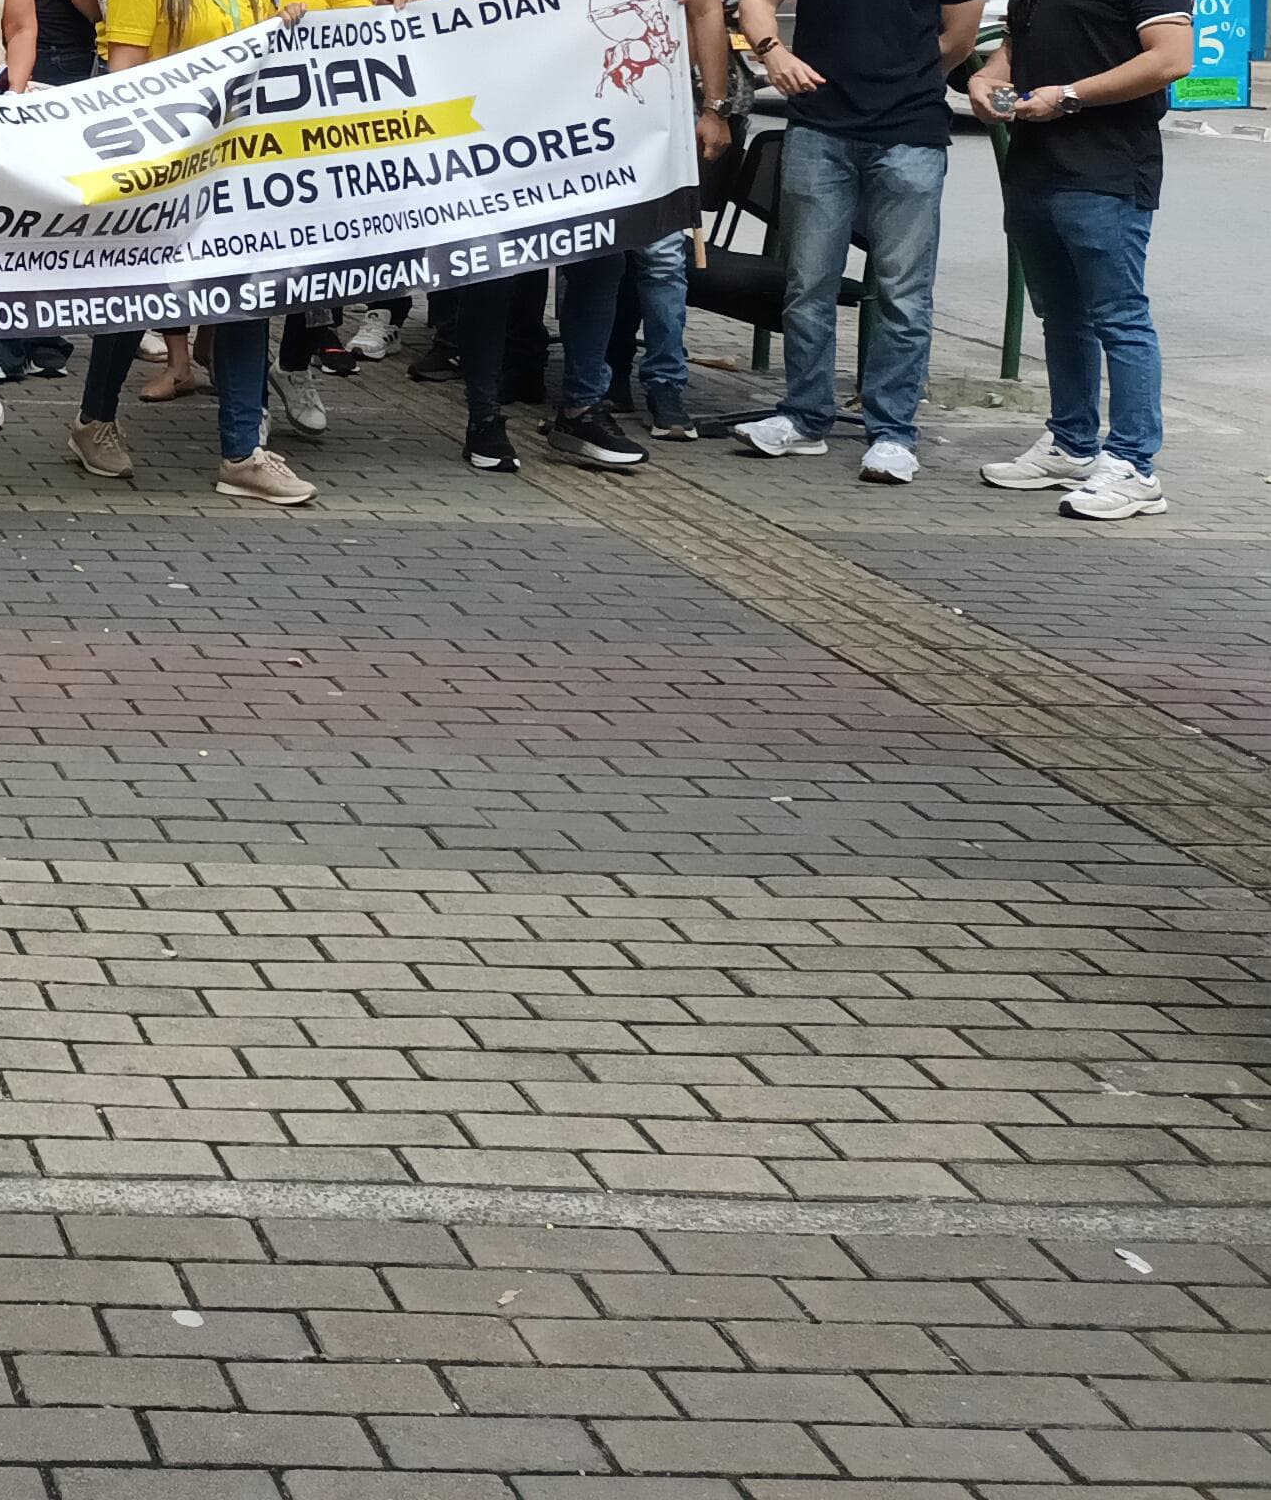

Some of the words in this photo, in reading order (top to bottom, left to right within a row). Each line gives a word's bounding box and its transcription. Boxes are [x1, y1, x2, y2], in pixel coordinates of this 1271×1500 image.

[71, 54, 227, 115] NACIONAL
[220, 36, 263, 65] DE
[265, 19, 387, 56] EMPLEADOS
[392, 15, 426, 43] DE
[431, 7, 474, 36] LA
[40, 211, 89, 238] LA
[91, 193, 190, 238] LUCHA
[194, 179, 235, 220] DE
[241, 169, 320, 212] LOS
[325, 116, 616, 202] TRABAJADORES
[111, 131, 284, 194] SUBDIRECTIVA
[301, 109, 437, 153] MONTERÍA
[72, 248, 95, 270] LA
[98, 243, 186, 270] MASACRE
[187, 229, 287, 262] LABORAL
[290, 222, 318, 248] DE
[322, 217, 361, 244] LOS
[362, 192, 510, 238] PROVISIONALES
[512, 183, 547, 209] EN
[547, 176, 579, 204] LA
[582, 164, 638, 195] DIAN
[35, 292, 182, 330] DERECHOS
[188, 286, 231, 318] NO
[239, 279, 277, 312] SE
[284, 256, 441, 306] MENDIGAN,
[449, 245, 491, 279] SE
[499, 218, 617, 270] EXIGEN
